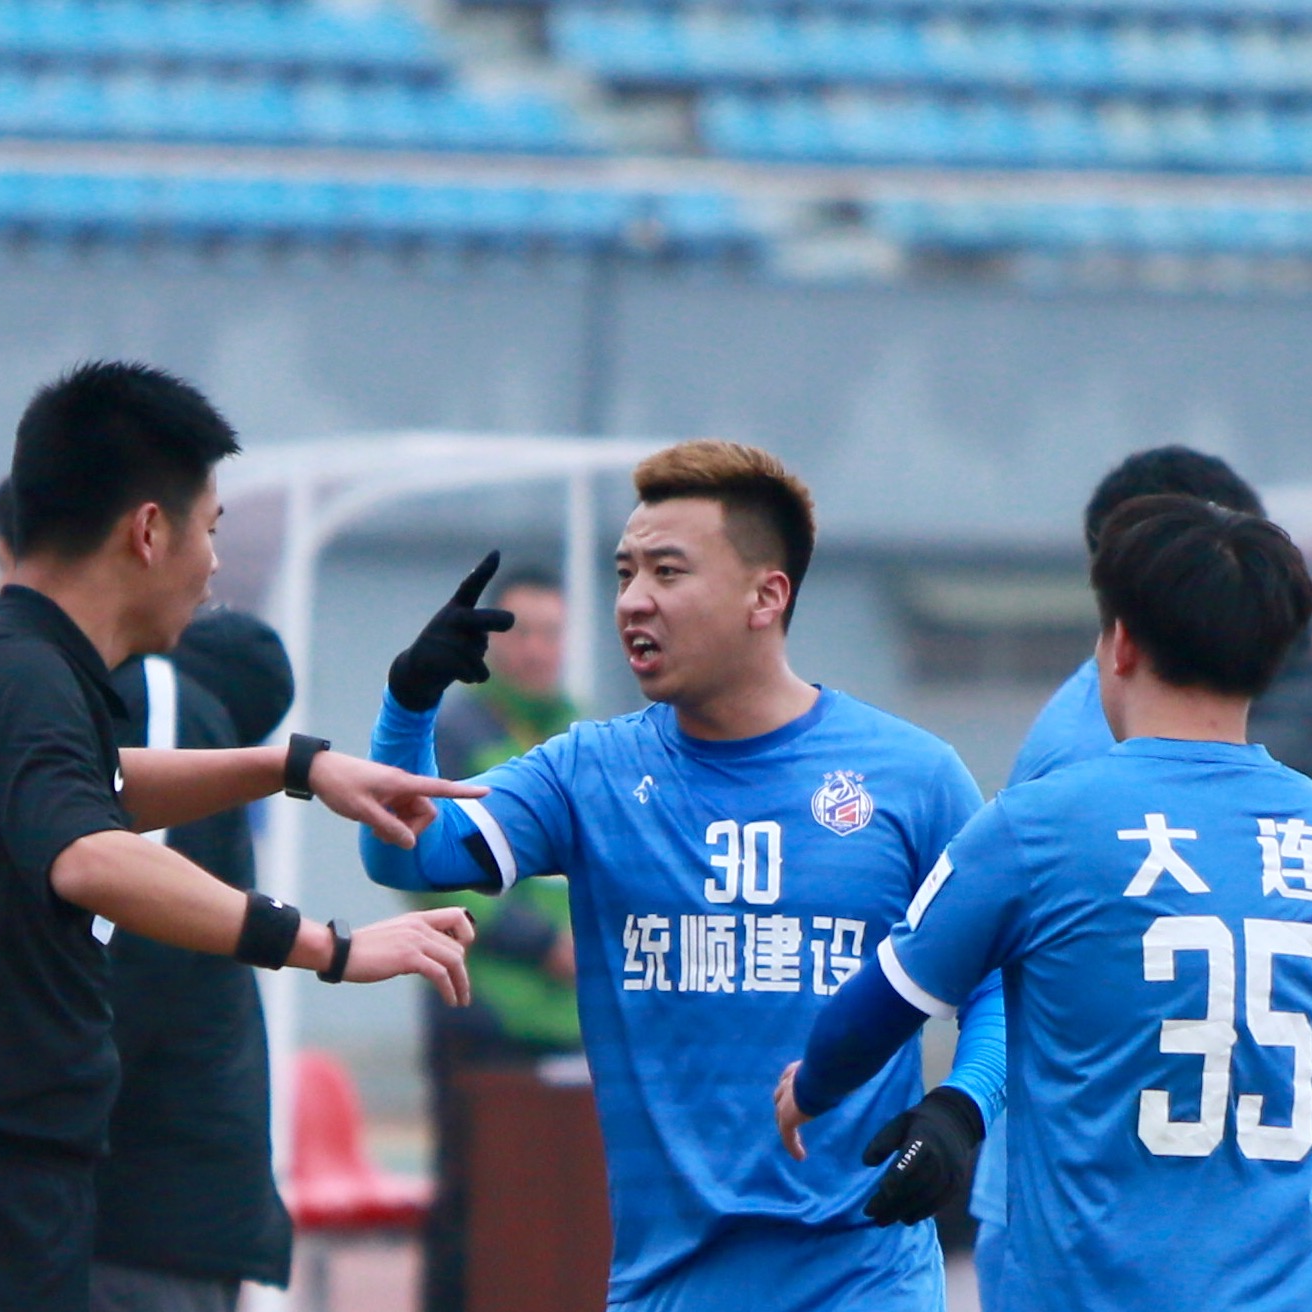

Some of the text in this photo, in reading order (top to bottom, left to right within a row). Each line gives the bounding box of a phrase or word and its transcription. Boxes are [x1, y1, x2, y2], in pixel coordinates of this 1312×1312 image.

[704, 819, 782, 905] 30
[623, 913, 866, 995] 统顺建设
[896, 1140, 923, 1171] KIPSTA
